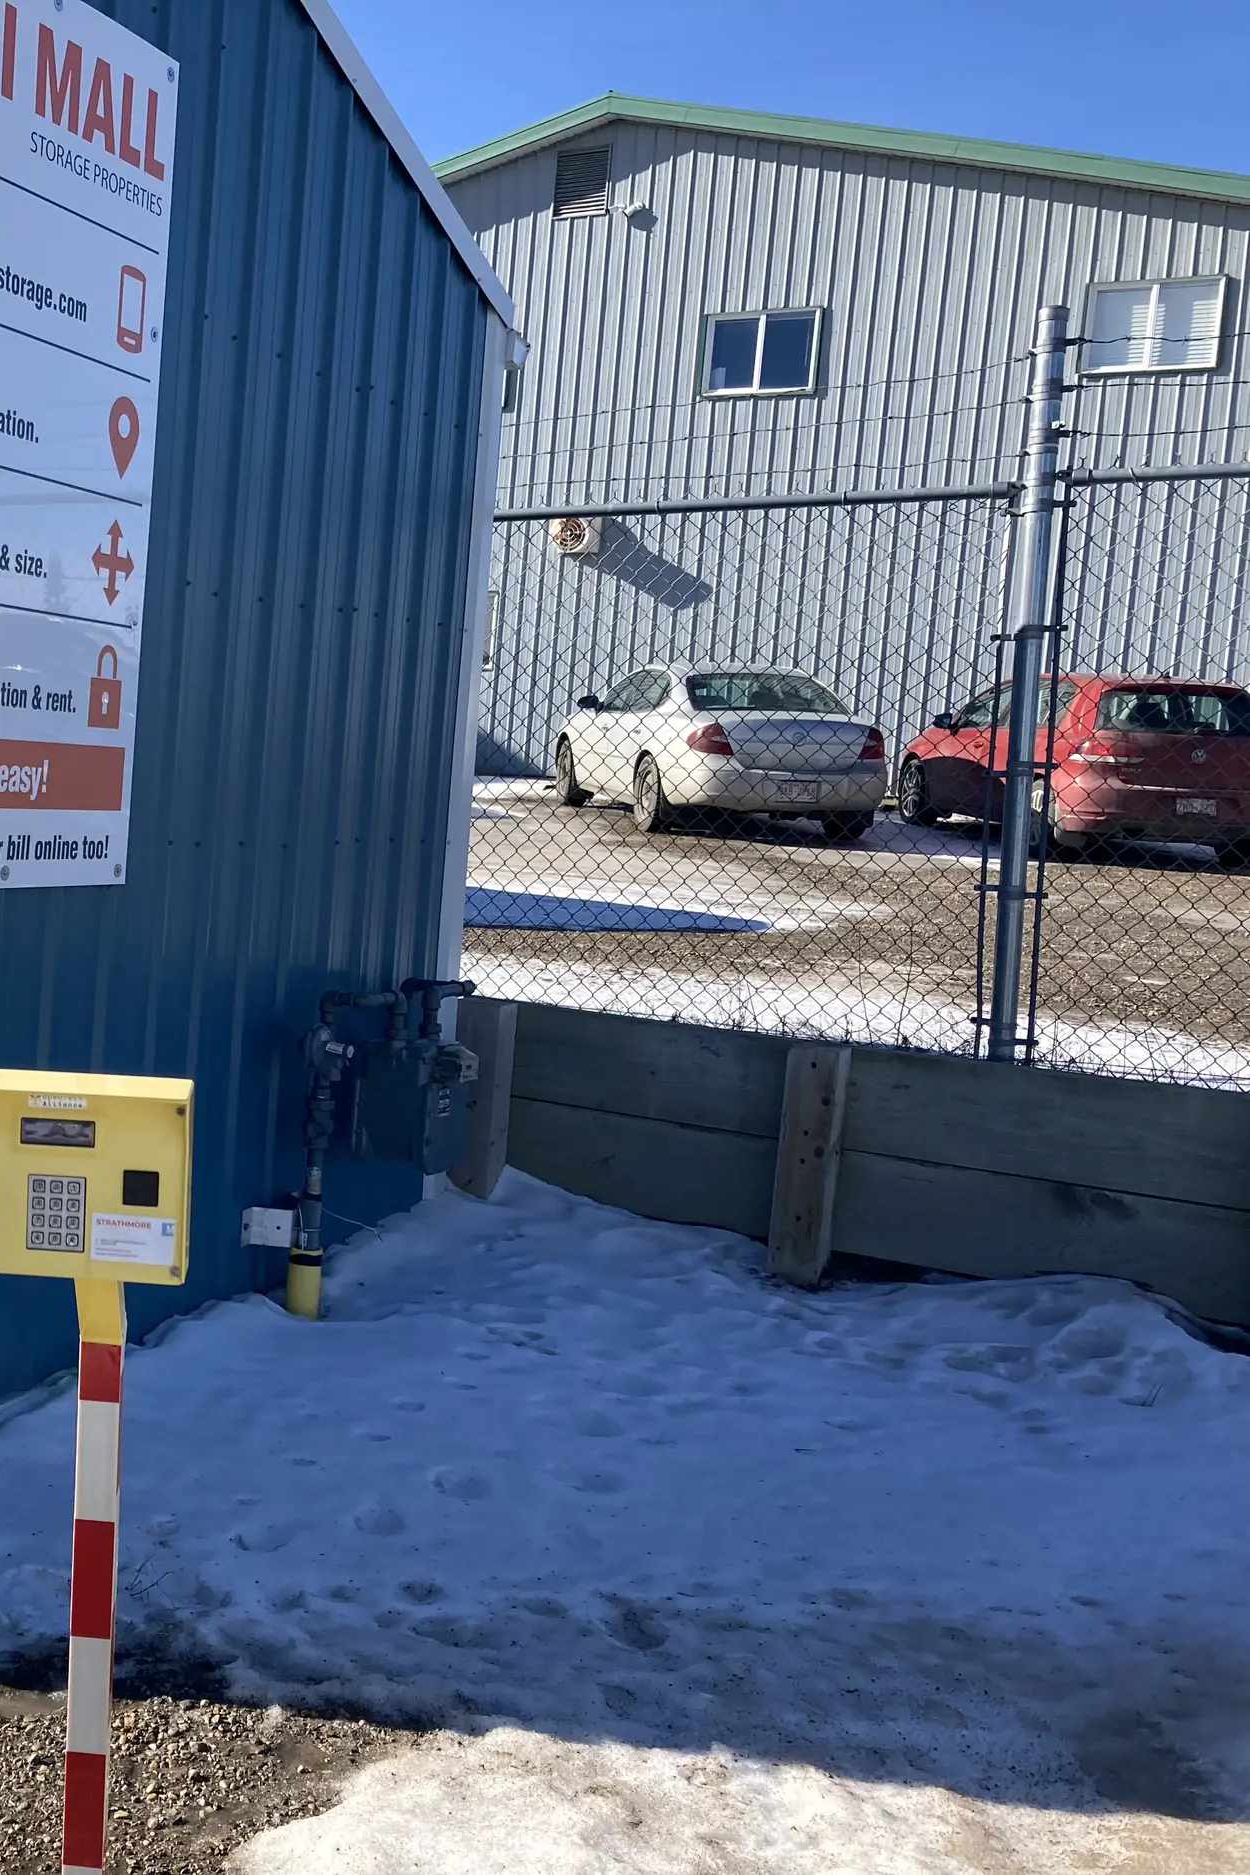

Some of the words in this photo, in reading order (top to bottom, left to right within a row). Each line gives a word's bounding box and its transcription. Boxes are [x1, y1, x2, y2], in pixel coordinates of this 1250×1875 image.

[35, 23, 165, 181] MALL
[30, 131, 90, 181] STORAGE
[93, 165, 163, 217] PROPERTIES
[0, 546, 10, 571] &
[14, 549, 47, 578] size.
[31, 685, 42, 710] &
[46, 689, 76, 713] rent.
[6, 834, 30, 860] bill
[34, 835, 78, 860] online
[82, 835, 109, 859] too!
[96, 1218, 152, 1230] STRATHMORE
